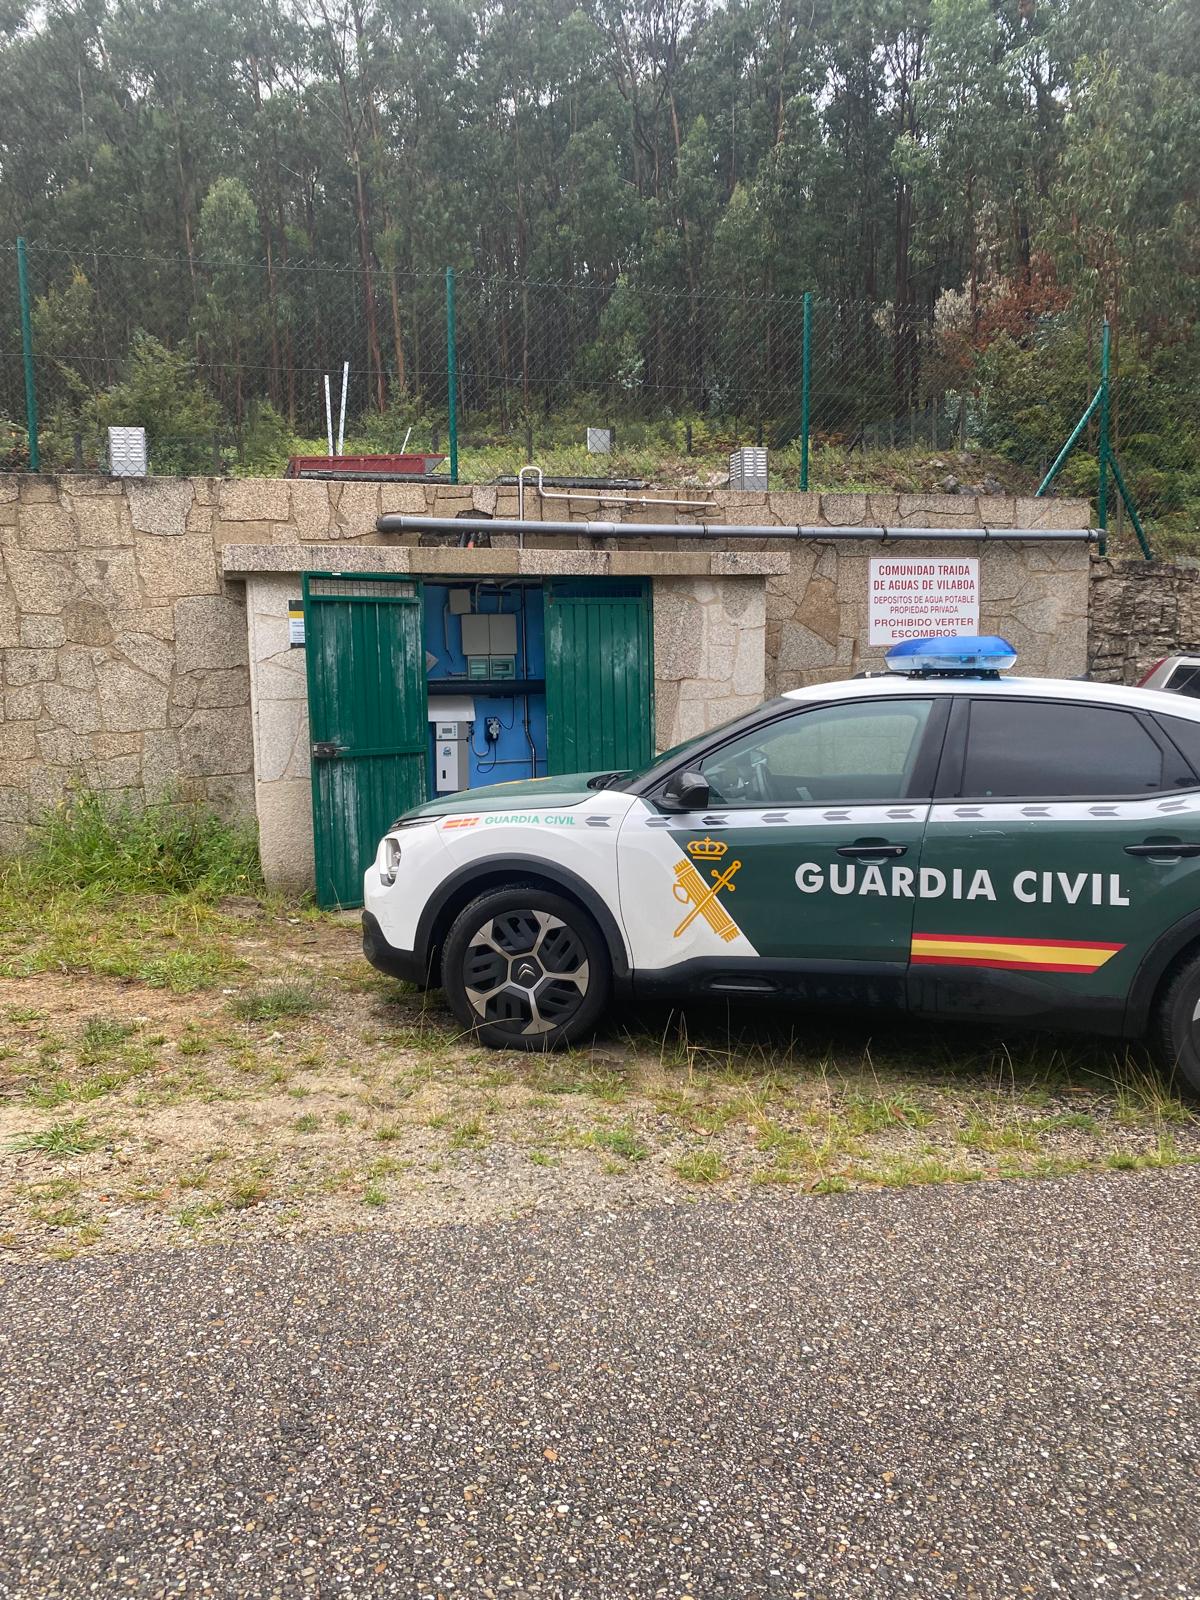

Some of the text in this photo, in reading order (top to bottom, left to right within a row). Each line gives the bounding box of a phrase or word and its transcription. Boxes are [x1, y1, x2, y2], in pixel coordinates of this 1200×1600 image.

[879, 565, 970, 576] COMUNIDAD TRAIDA
[873, 580, 975, 590] DE AGUAS DE VILABOA
[874, 595, 975, 604] DEPOSITOS DE AGUA POTABLE
[890, 606, 929, 614] PROPIEDAD
[874, 619, 932, 627] PROHIBIDO
[891, 629, 957, 638] ESCOMBROS
[485, 815, 576, 825] GUARDIA CIVIL
[794, 862, 1130, 907] GUARDIA CIVIL
